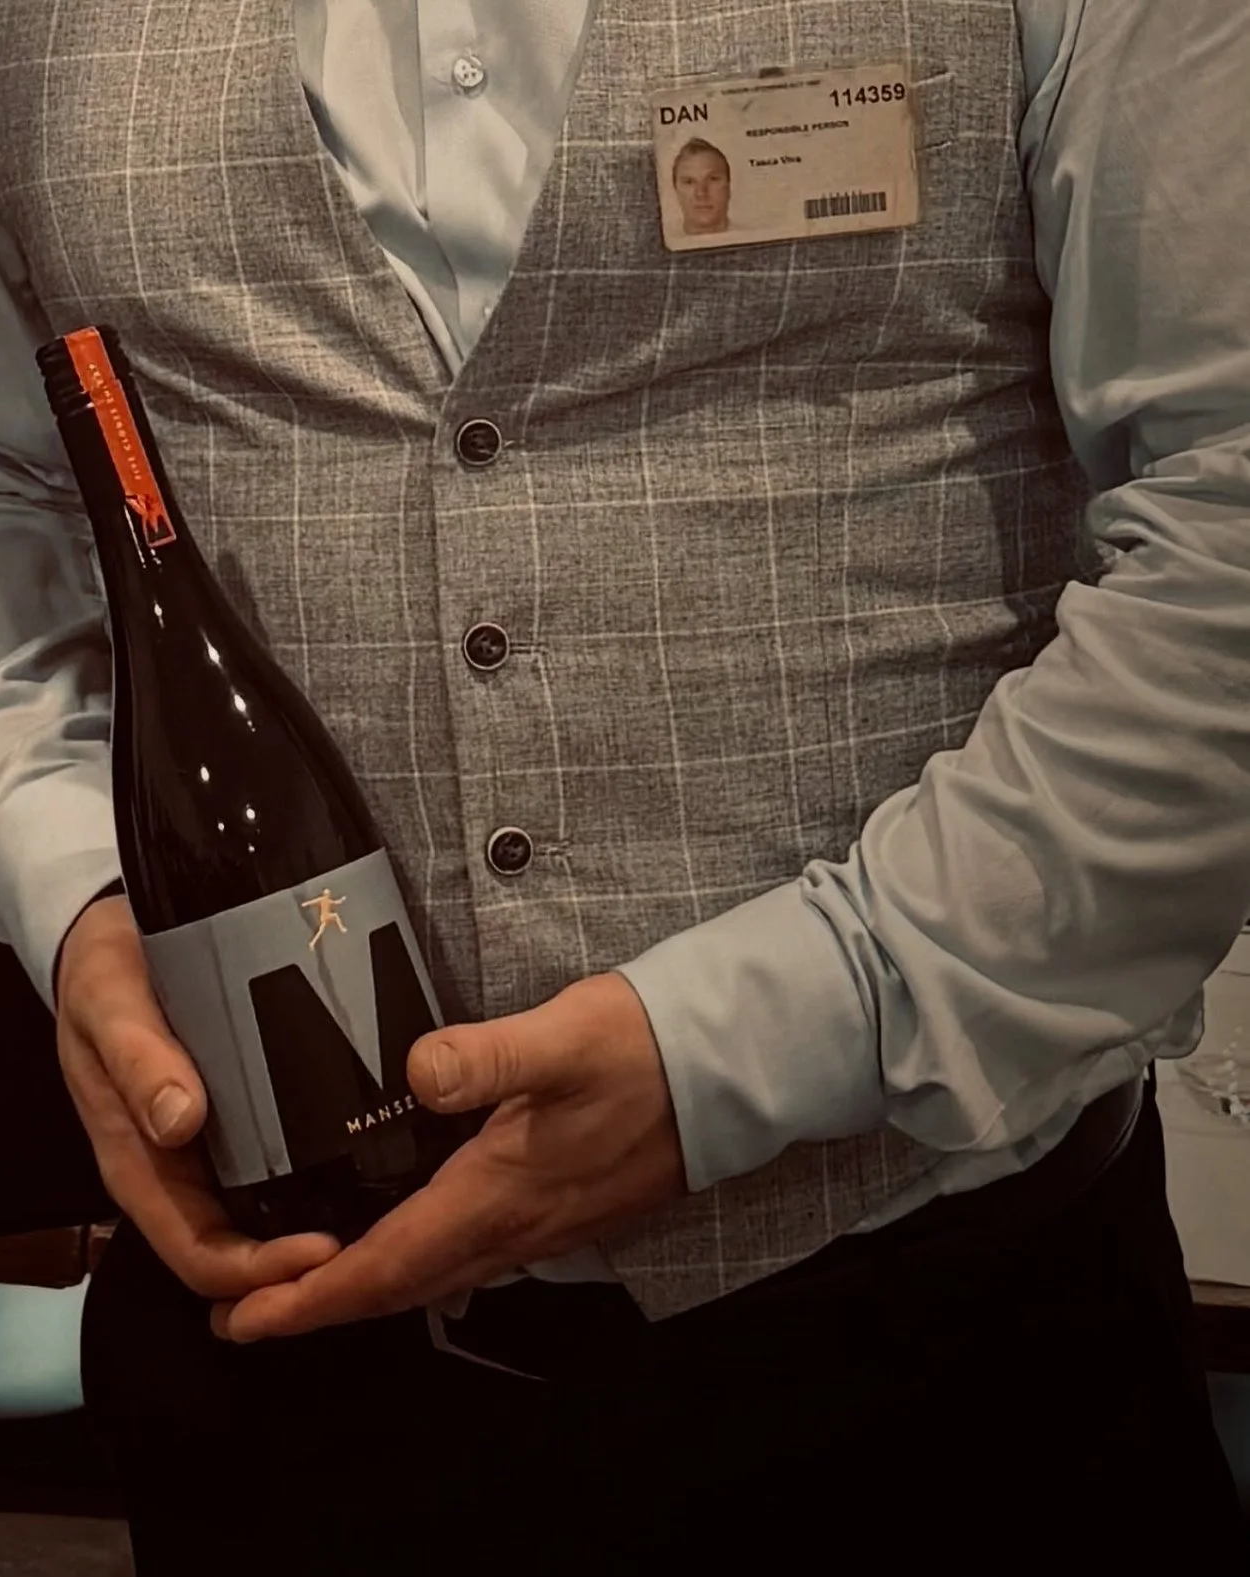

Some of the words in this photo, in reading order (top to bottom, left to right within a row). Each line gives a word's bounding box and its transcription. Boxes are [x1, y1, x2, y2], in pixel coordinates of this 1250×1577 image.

[830, 82, 906, 107] 114359
[659, 103, 709, 125] DAN
[346, 1094, 418, 1134] MANSE
